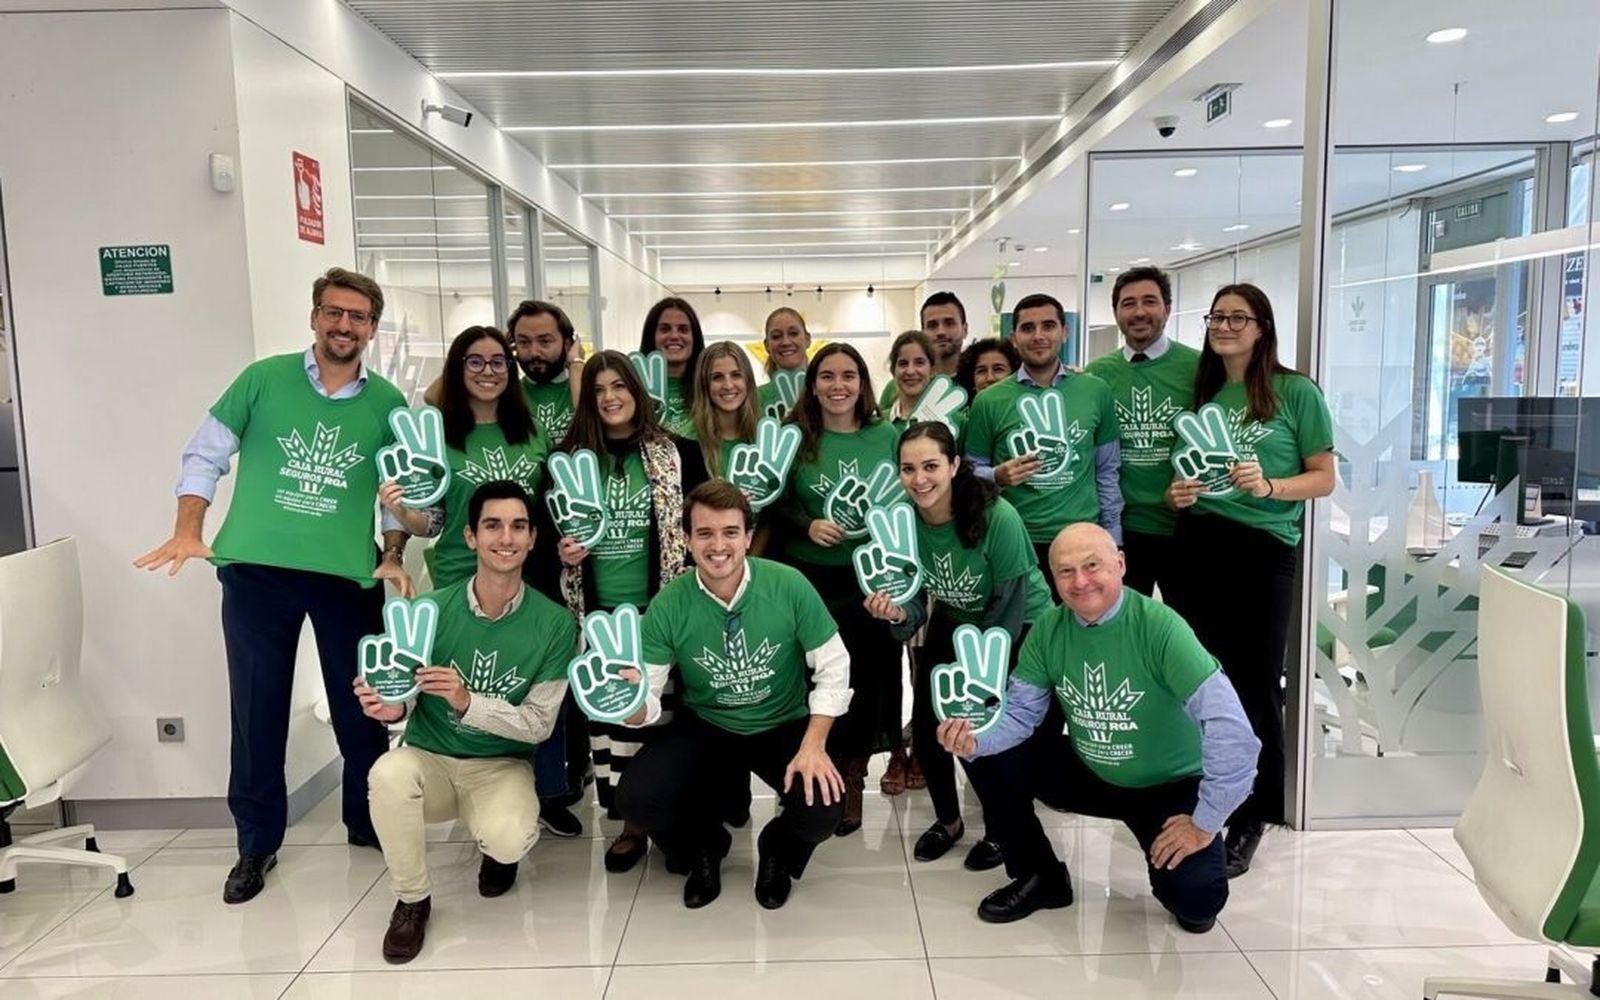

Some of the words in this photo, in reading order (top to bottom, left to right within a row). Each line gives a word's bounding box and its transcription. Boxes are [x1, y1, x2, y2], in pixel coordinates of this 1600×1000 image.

[103, 247, 167, 259] ATENCION
[1152, 430, 1175, 438] RGA
[288, 459, 311, 472] CAJA
[314, 465, 346, 479] RURAL
[280, 466, 322, 484] SEGUROS
[323, 477, 348, 489] RGA
[615, 510, 648, 519] RURAL
[627, 519, 650, 528] RGA
[738, 665, 770, 677] RURAL
[751, 669, 776, 681] RGA
[1073, 707, 1094, 719] CAJA
[1096, 711, 1132, 721] RURAL
[1071, 715, 1107, 730] SEGUROS
[1109, 721, 1139, 731] RGA
